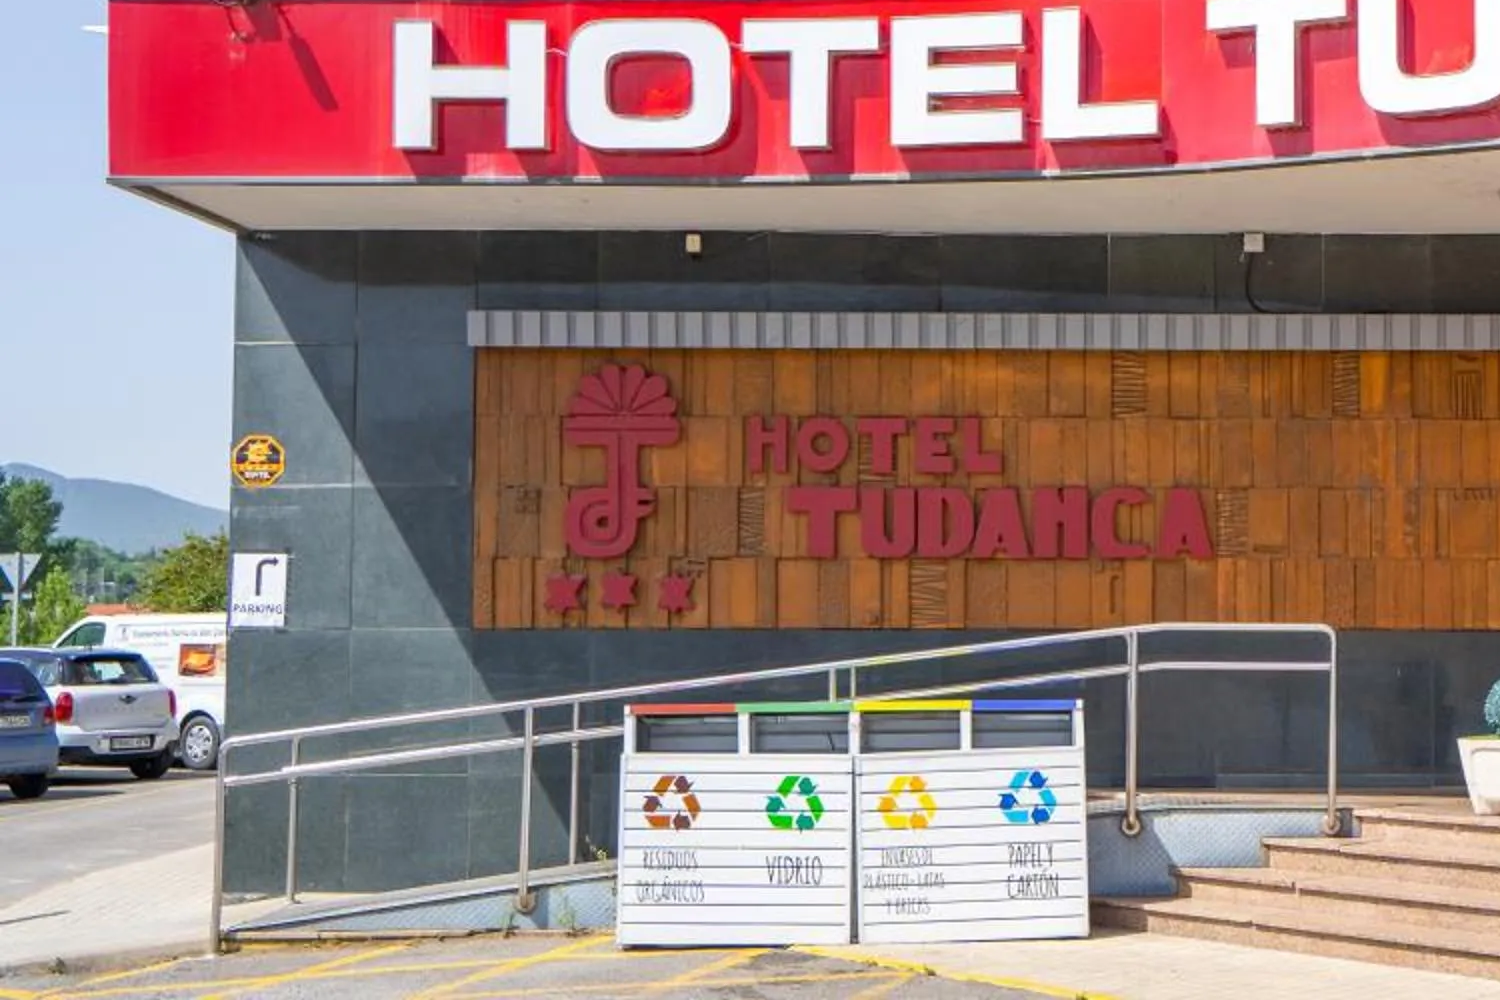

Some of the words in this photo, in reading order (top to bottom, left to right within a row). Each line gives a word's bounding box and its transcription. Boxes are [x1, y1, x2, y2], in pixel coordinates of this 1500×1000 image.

[391, 5, 1163, 153] HOTEL
[745, 415, 1006, 475] HOTEL
[232, 603, 284, 615] PARKING
[642, 849, 700, 870] RESIDUOS
[765, 855, 824, 886] VIDRIO
[1007, 842, 1043, 868] PAPEL
[1007, 867, 1059, 899] CARTÓN
